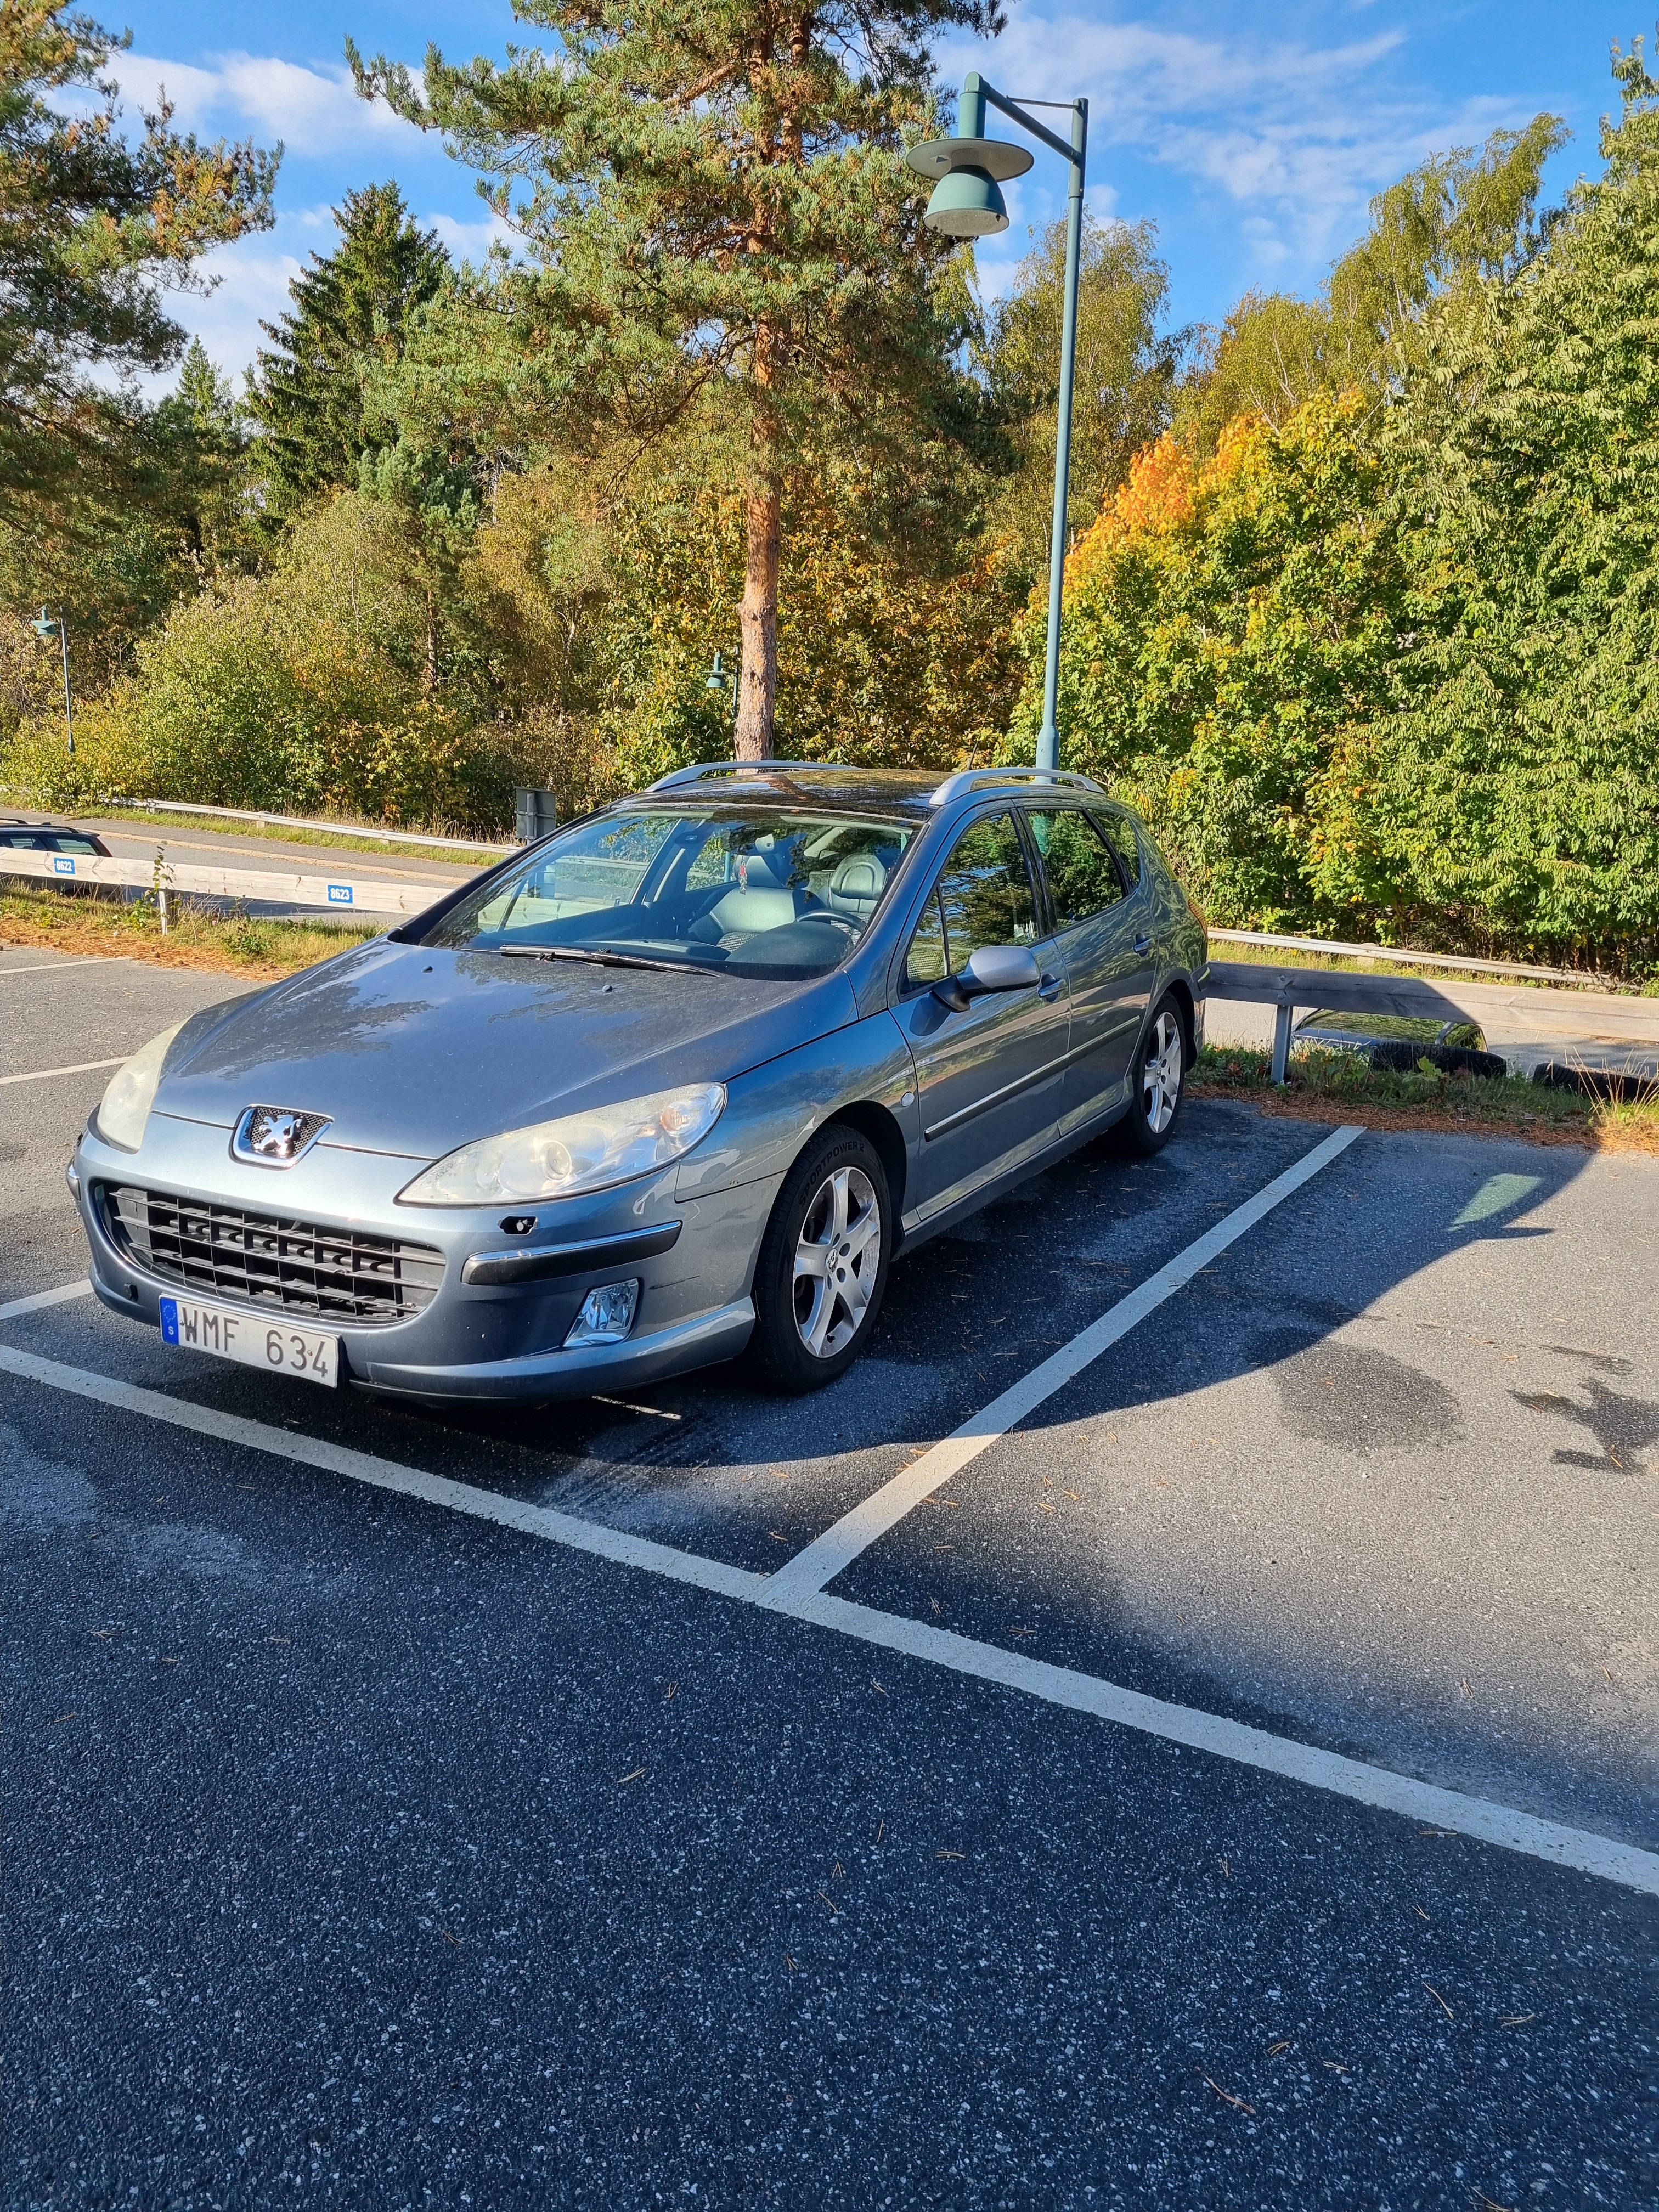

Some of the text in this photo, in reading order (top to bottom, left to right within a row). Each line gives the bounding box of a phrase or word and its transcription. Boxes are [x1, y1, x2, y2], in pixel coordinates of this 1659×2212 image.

[56, 860, 72, 872] 8622
[330, 888, 350, 900] 8623
[799, 1141, 865, 1207] SPORTPOWER 2
[168, 1325, 174, 1335] S
[182, 1306, 329, 1379] WMF 634
